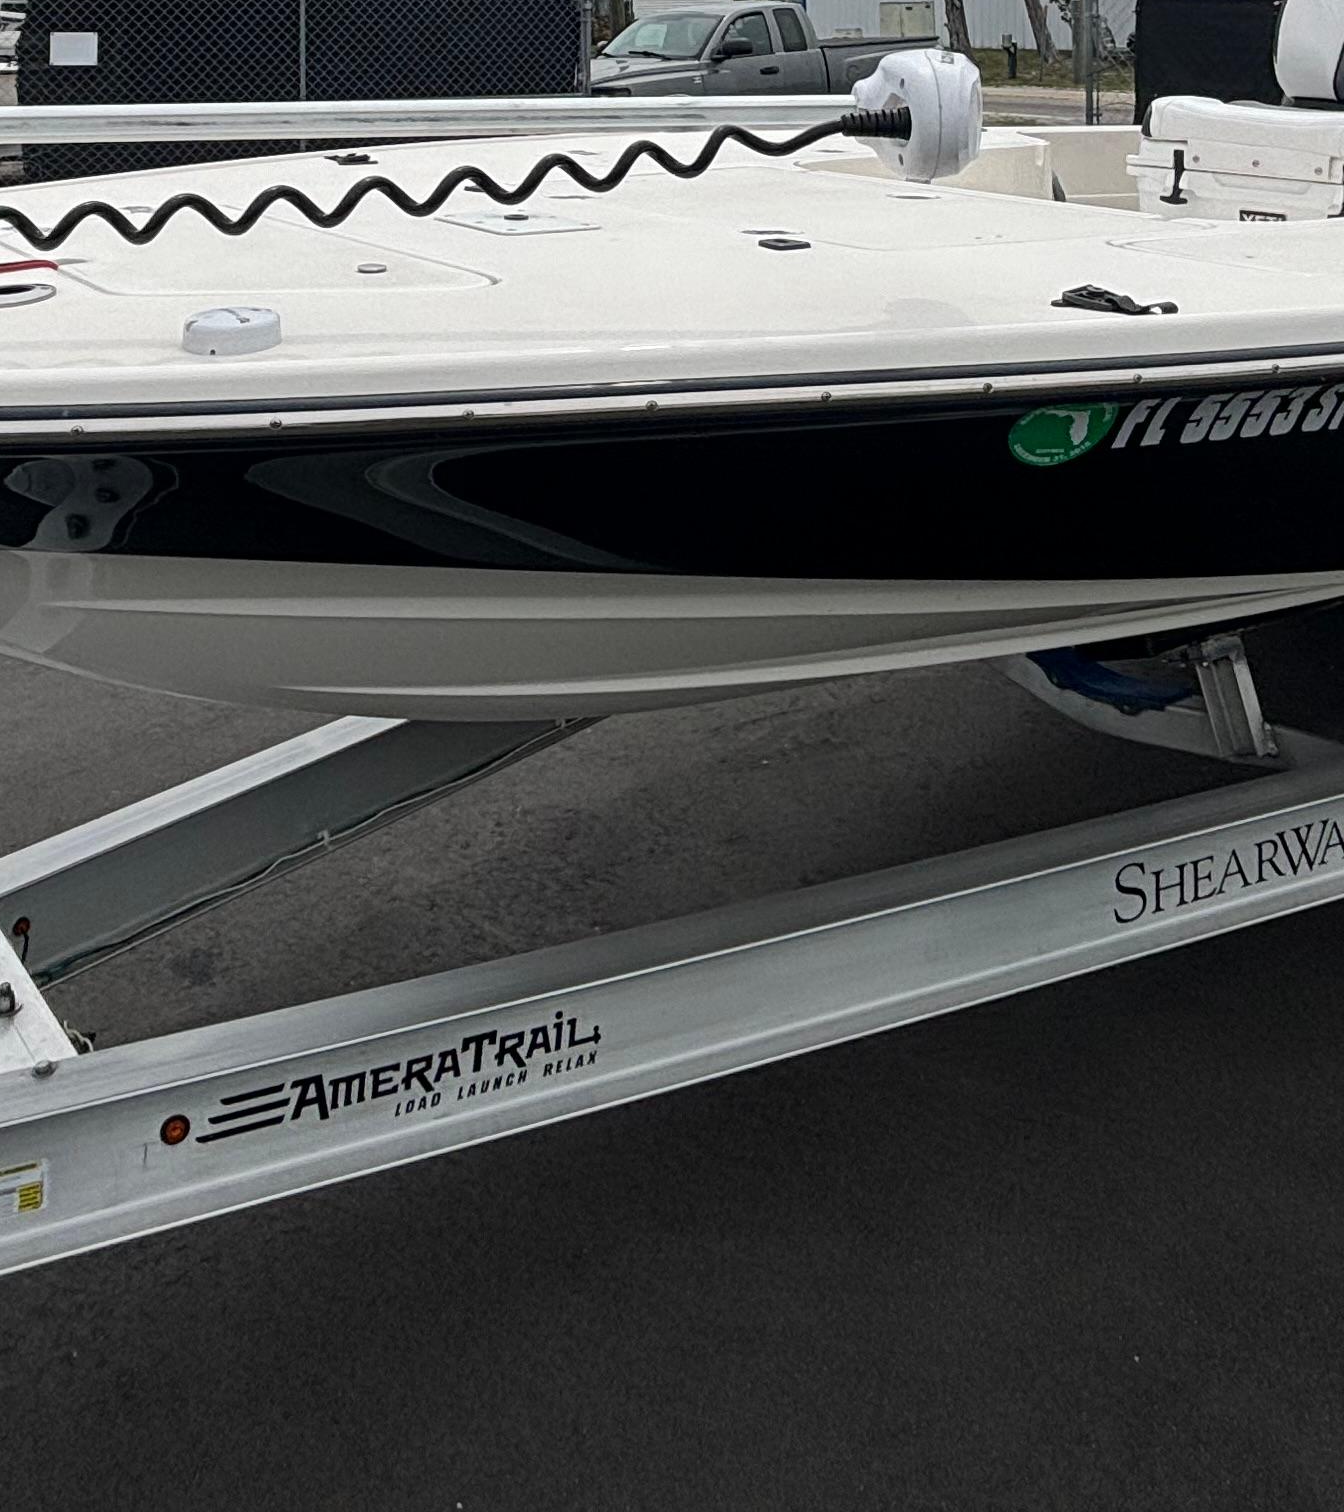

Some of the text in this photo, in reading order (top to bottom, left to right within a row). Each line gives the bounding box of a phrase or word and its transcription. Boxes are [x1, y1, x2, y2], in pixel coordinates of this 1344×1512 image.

[1111, 396, 1183, 449] FL
[394, 1049, 598, 1118] LOAD LAUNCH RELAX
